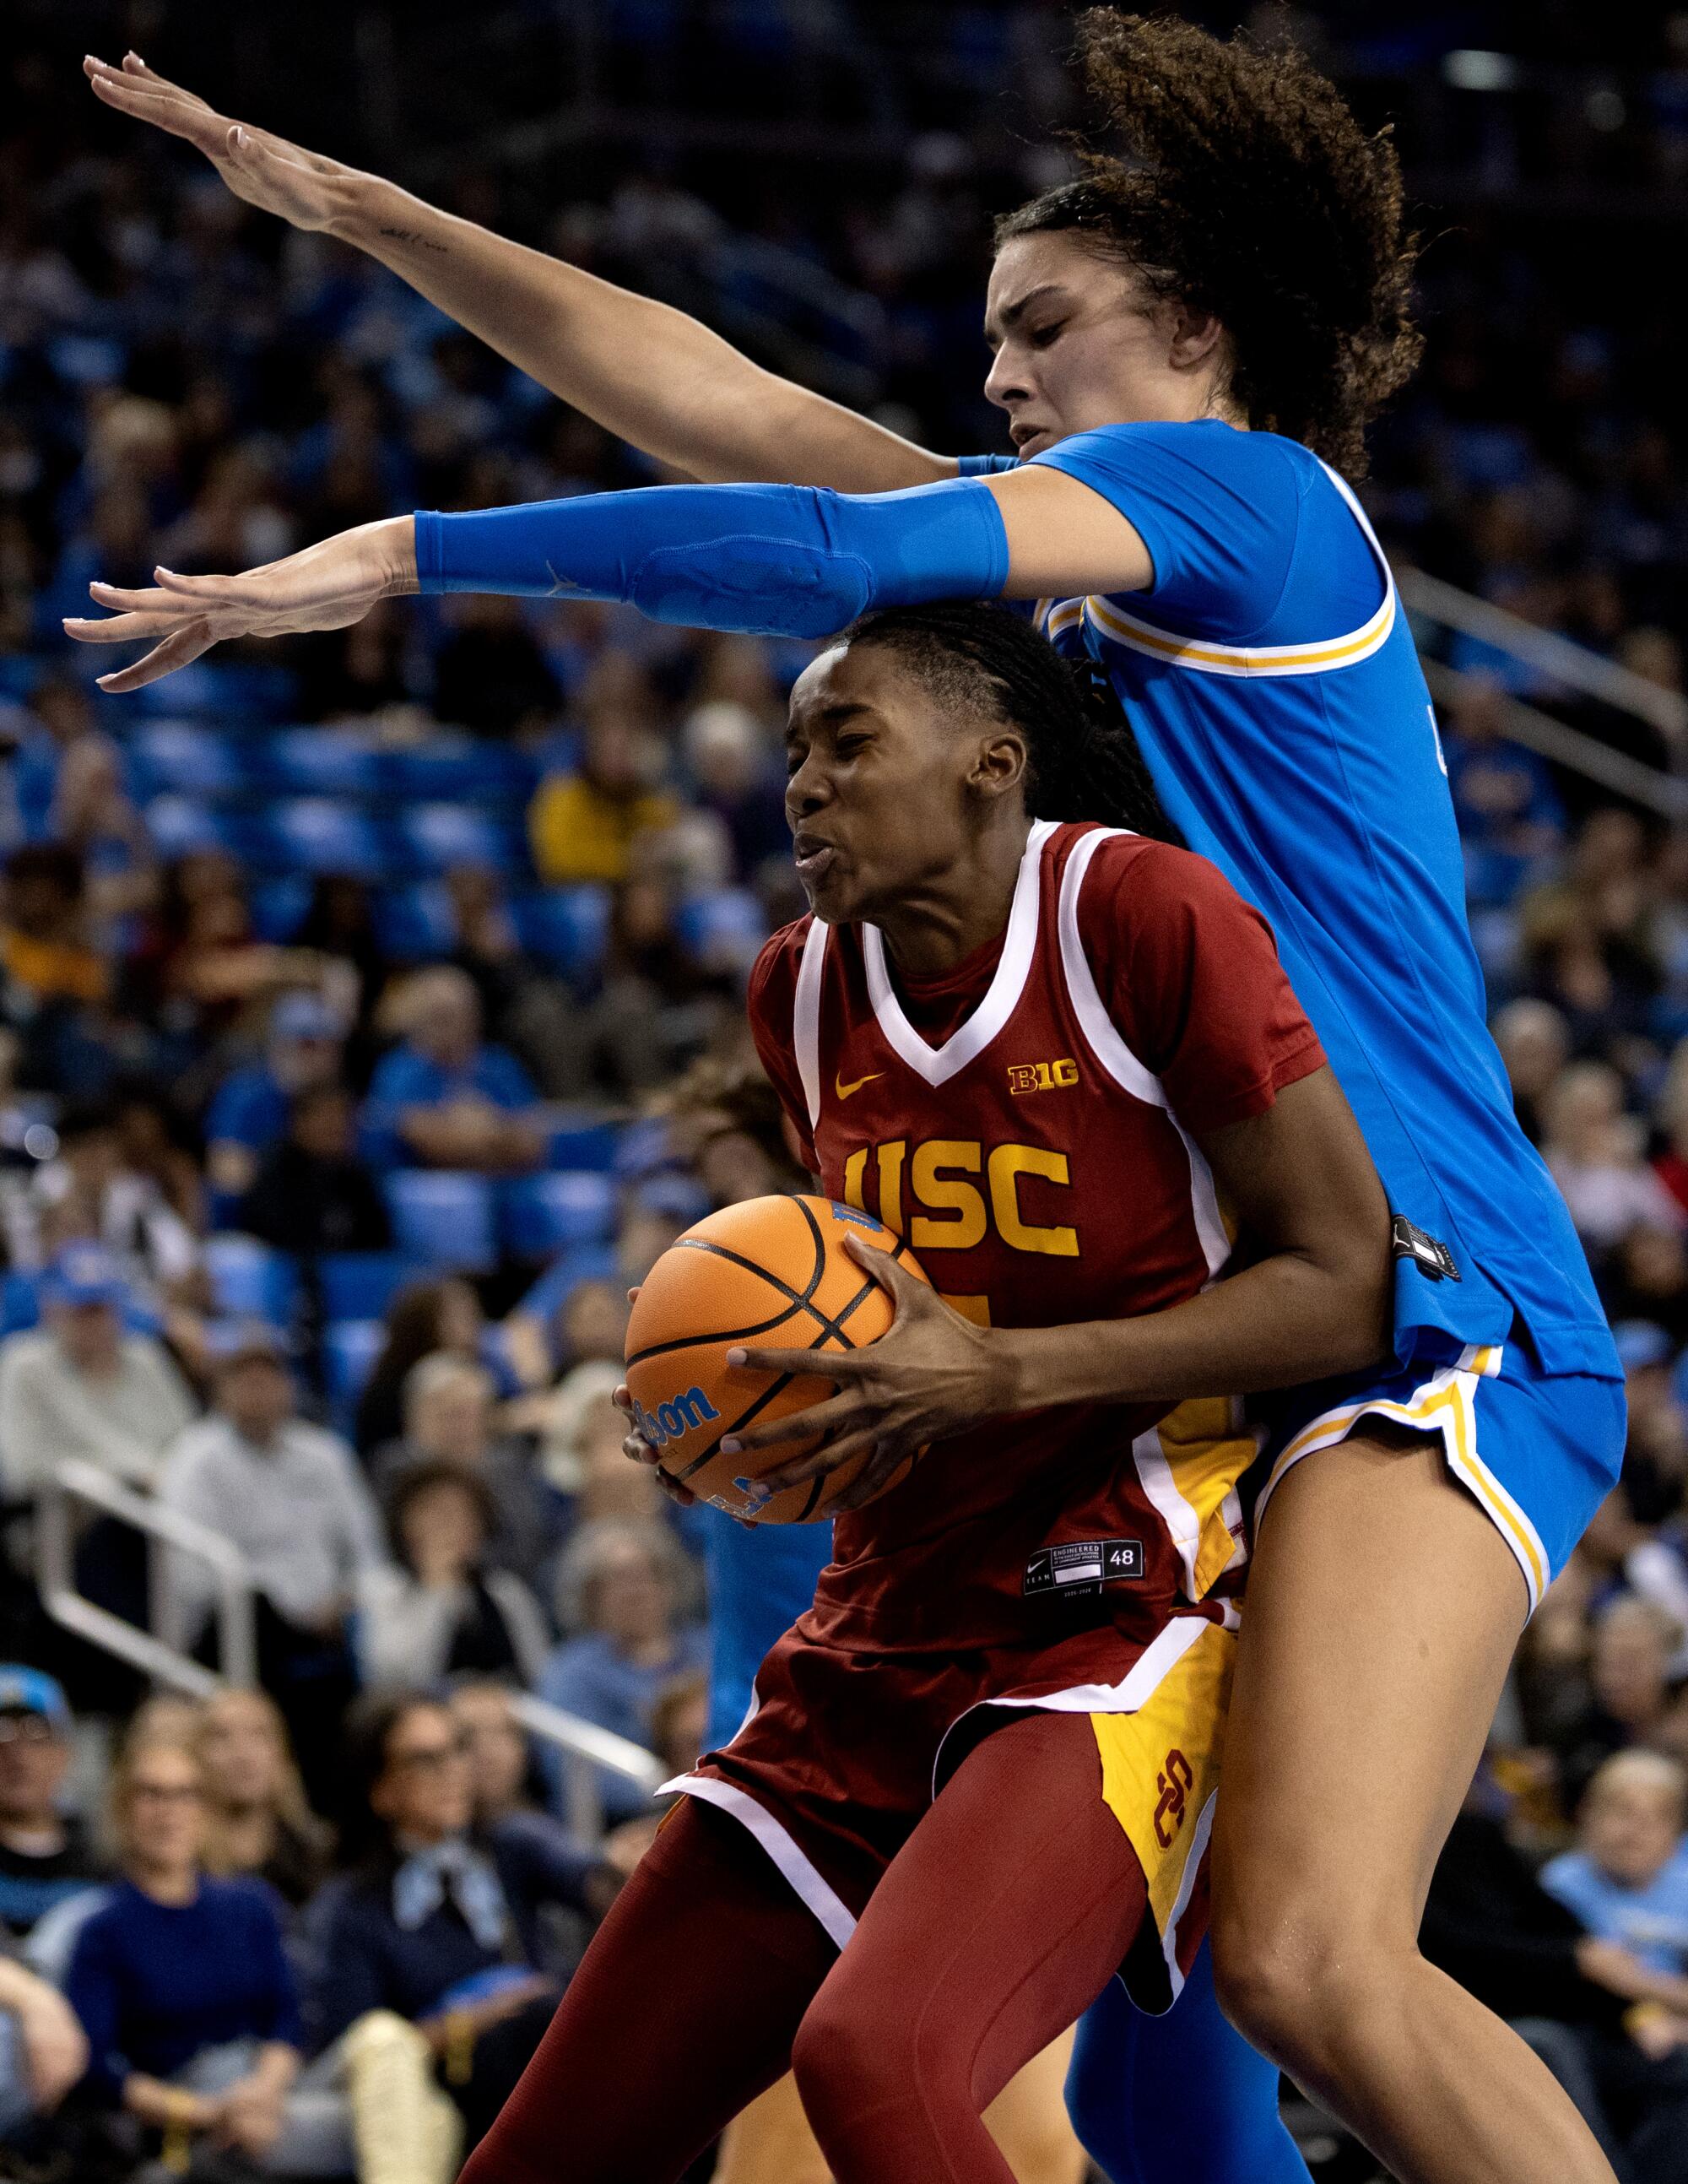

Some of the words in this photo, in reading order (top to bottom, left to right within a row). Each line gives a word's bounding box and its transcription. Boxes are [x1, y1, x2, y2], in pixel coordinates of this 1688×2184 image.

[845, 1140, 1079, 1257] USC
[1053, 1546, 1100, 1557] ENGINEERED
[1110, 1550, 1133, 1565] 48
[1026, 1574, 1050, 1585] TEAM
